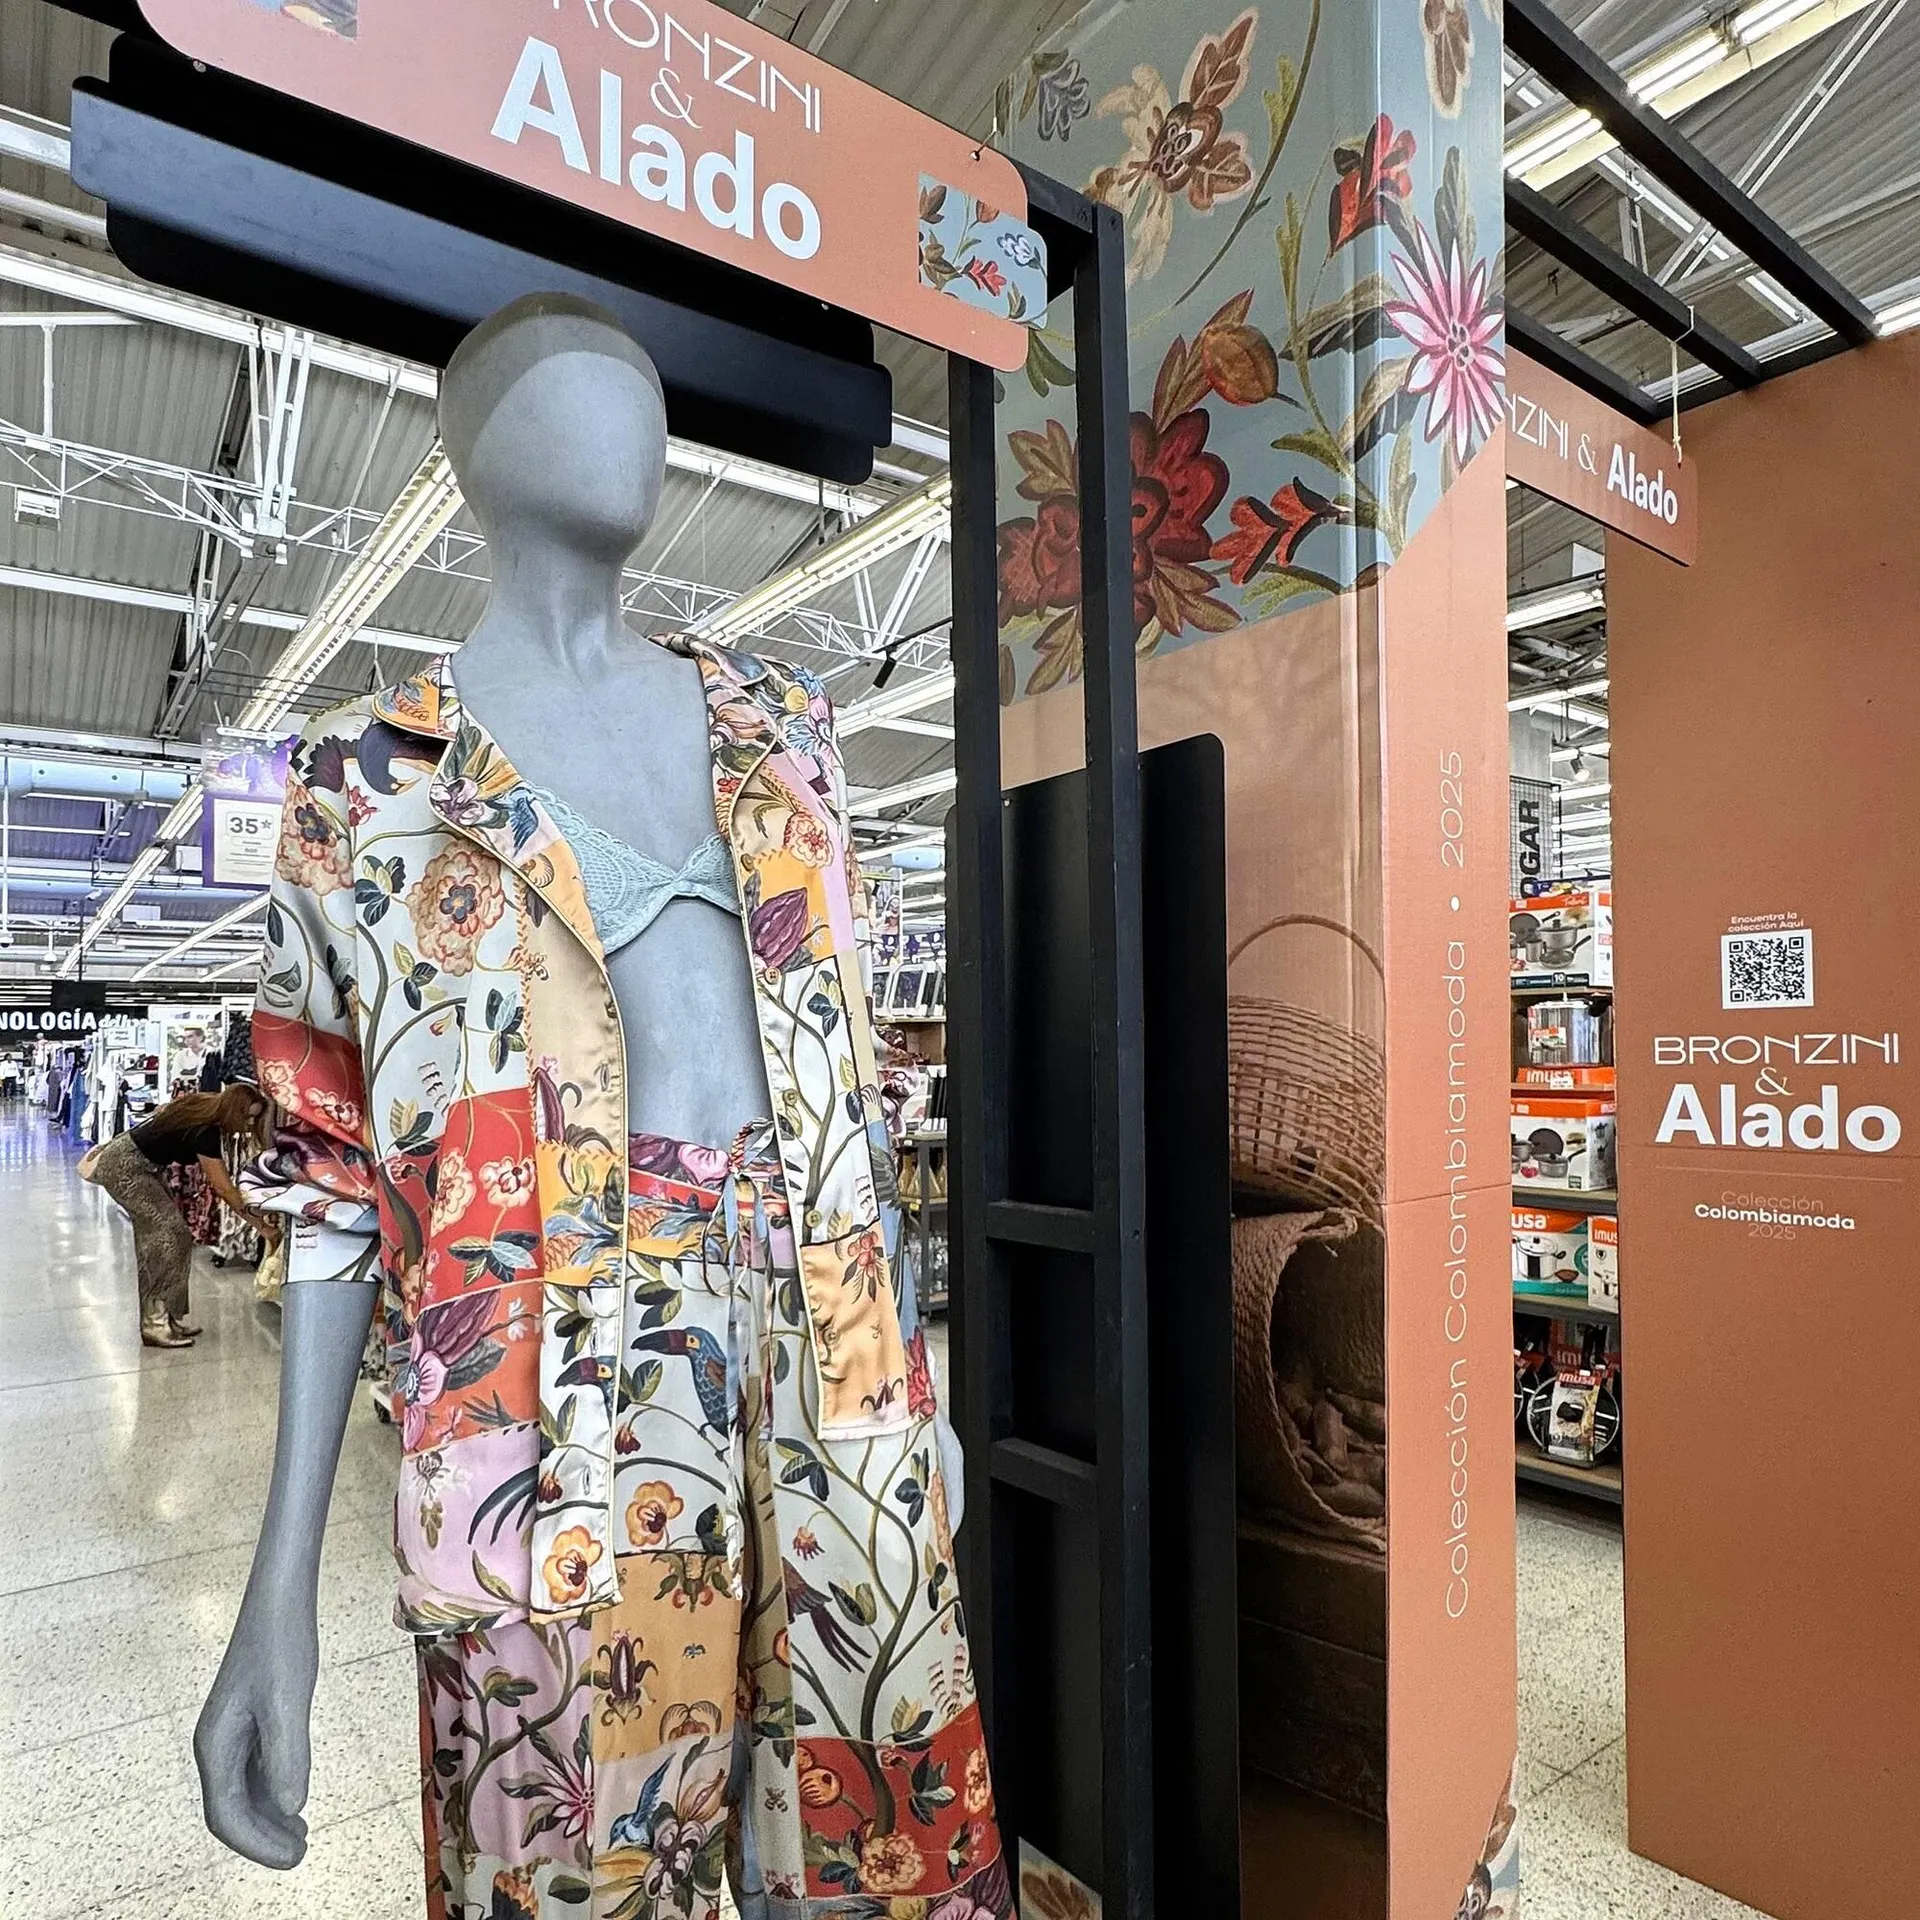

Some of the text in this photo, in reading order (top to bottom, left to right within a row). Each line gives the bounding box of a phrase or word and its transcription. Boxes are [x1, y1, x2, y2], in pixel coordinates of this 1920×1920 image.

[650, 67, 703, 129] &
[490, 35, 821, 260] Alado
[1577, 433, 1598, 475] &
[1606, 443, 1678, 525] Alado
[1727, 922, 1777, 932] colección
[1731, 911, 1798, 924] Encuentra la
[1653, 1033, 1900, 1065] BRONZINI
[1754, 1066, 1795, 1096] &
[1654, 1083, 1902, 1152] Alado
[1440, 750, 1469, 1618] Colección Colombiamoda 2025
[1720, 1190, 1824, 1212] Colección
[1694, 1204, 1856, 1230] Colombiamoda
[1748, 1223, 1797, 1241] 2025
